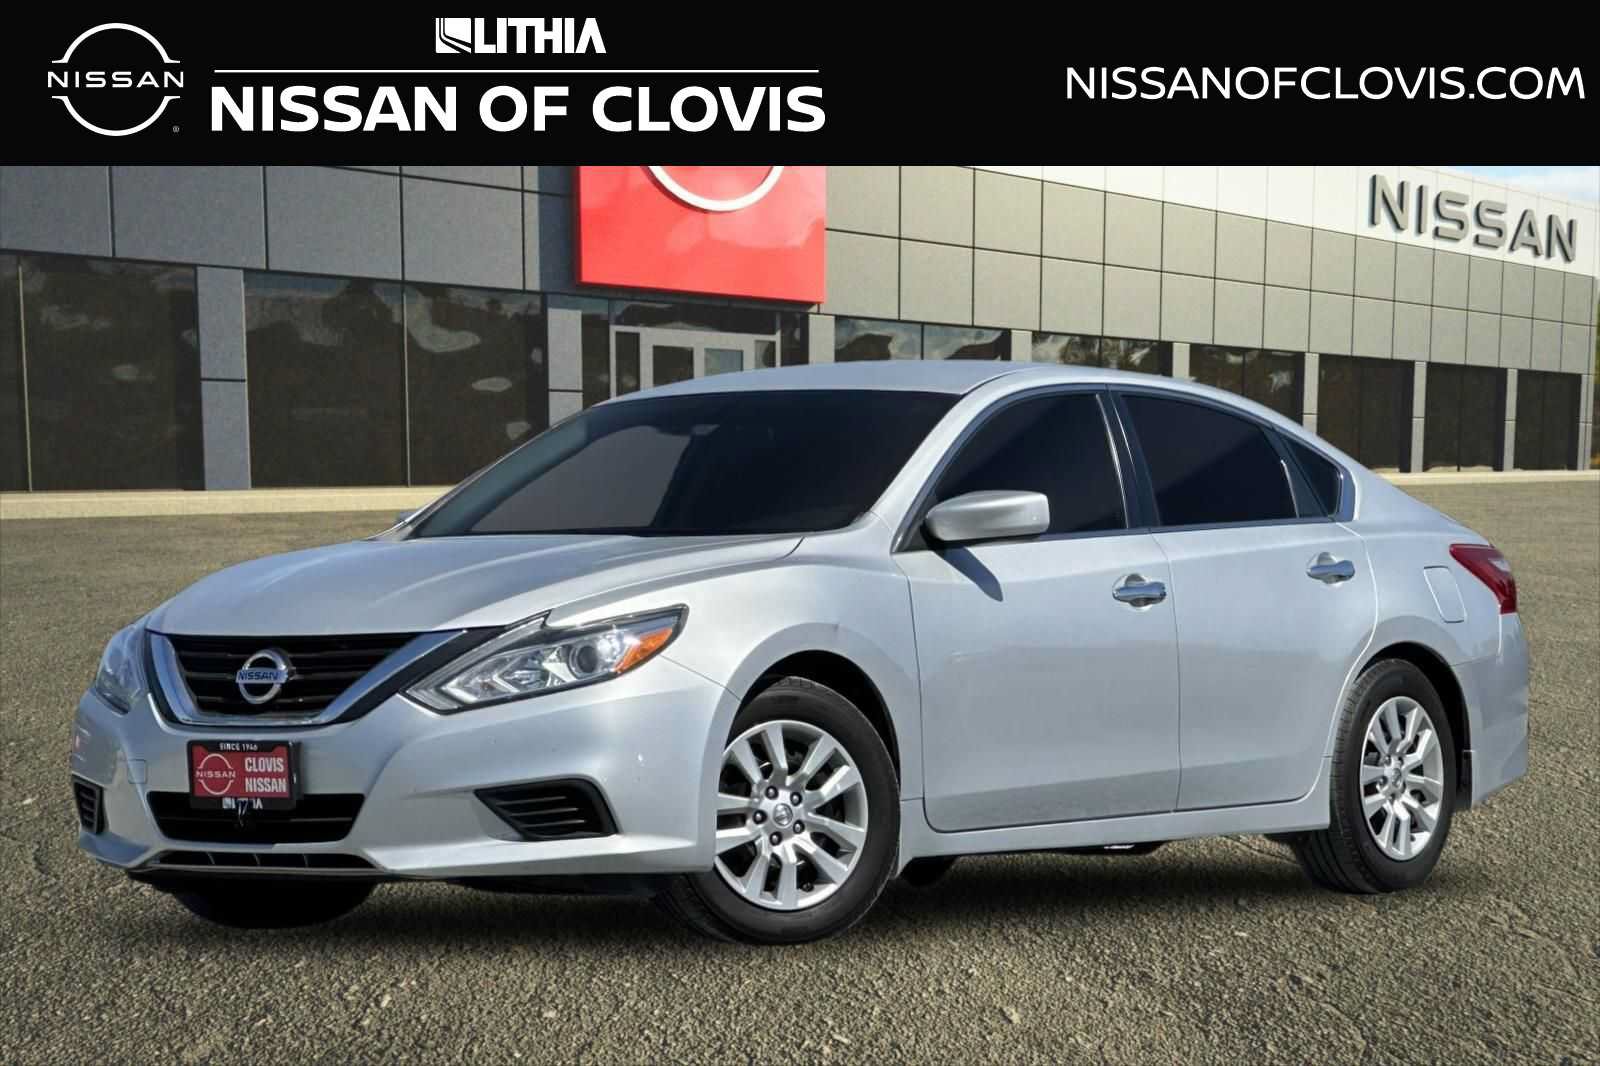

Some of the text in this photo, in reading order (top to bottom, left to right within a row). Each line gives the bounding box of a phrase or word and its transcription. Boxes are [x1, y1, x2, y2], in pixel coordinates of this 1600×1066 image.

[1368, 174, 1577, 262] NISSAN
[239, 671, 279, 681] NISSAN
[220, 742, 240, 751] SINCE
[244, 757, 284, 772] CLOVIS
[195, 770, 236, 778] NISSAN
[244, 777, 287, 793] NISSAN
